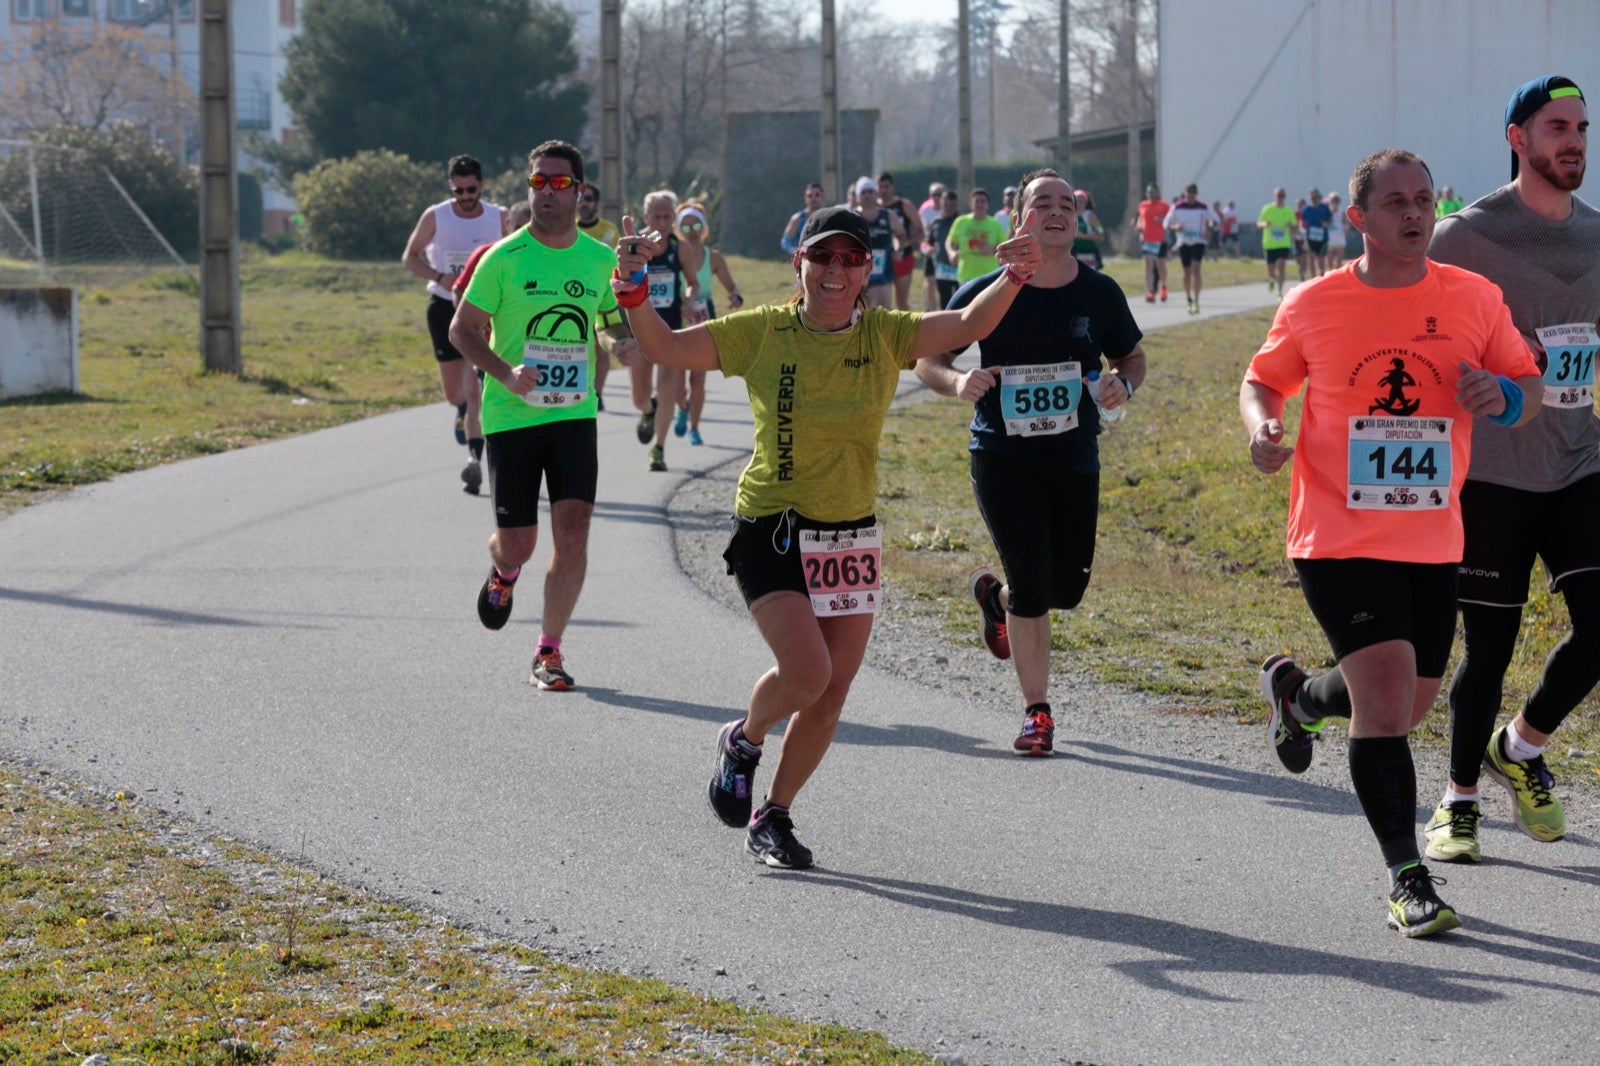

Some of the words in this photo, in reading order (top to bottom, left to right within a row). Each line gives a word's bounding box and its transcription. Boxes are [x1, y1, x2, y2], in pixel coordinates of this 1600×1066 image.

[535, 363, 579, 388] 592
[1018, 366, 1032, 376] GRAN
[1033, 366, 1052, 374] PREMIO
[1060, 364, 1076, 372] FONDO
[1556, 350, 1594, 381] 311
[1014, 385, 1070, 415] 588
[777, 363, 797, 482] PANCIVERDE
[1377, 420, 1394, 428] GRAN
[1396, 419, 1419, 430] PREMIO
[1420, 420, 1428, 430] DE
[1368, 446, 1438, 480] 144
[805, 553, 877, 589] 2063
[1457, 566, 1500, 579] GIVOVA
